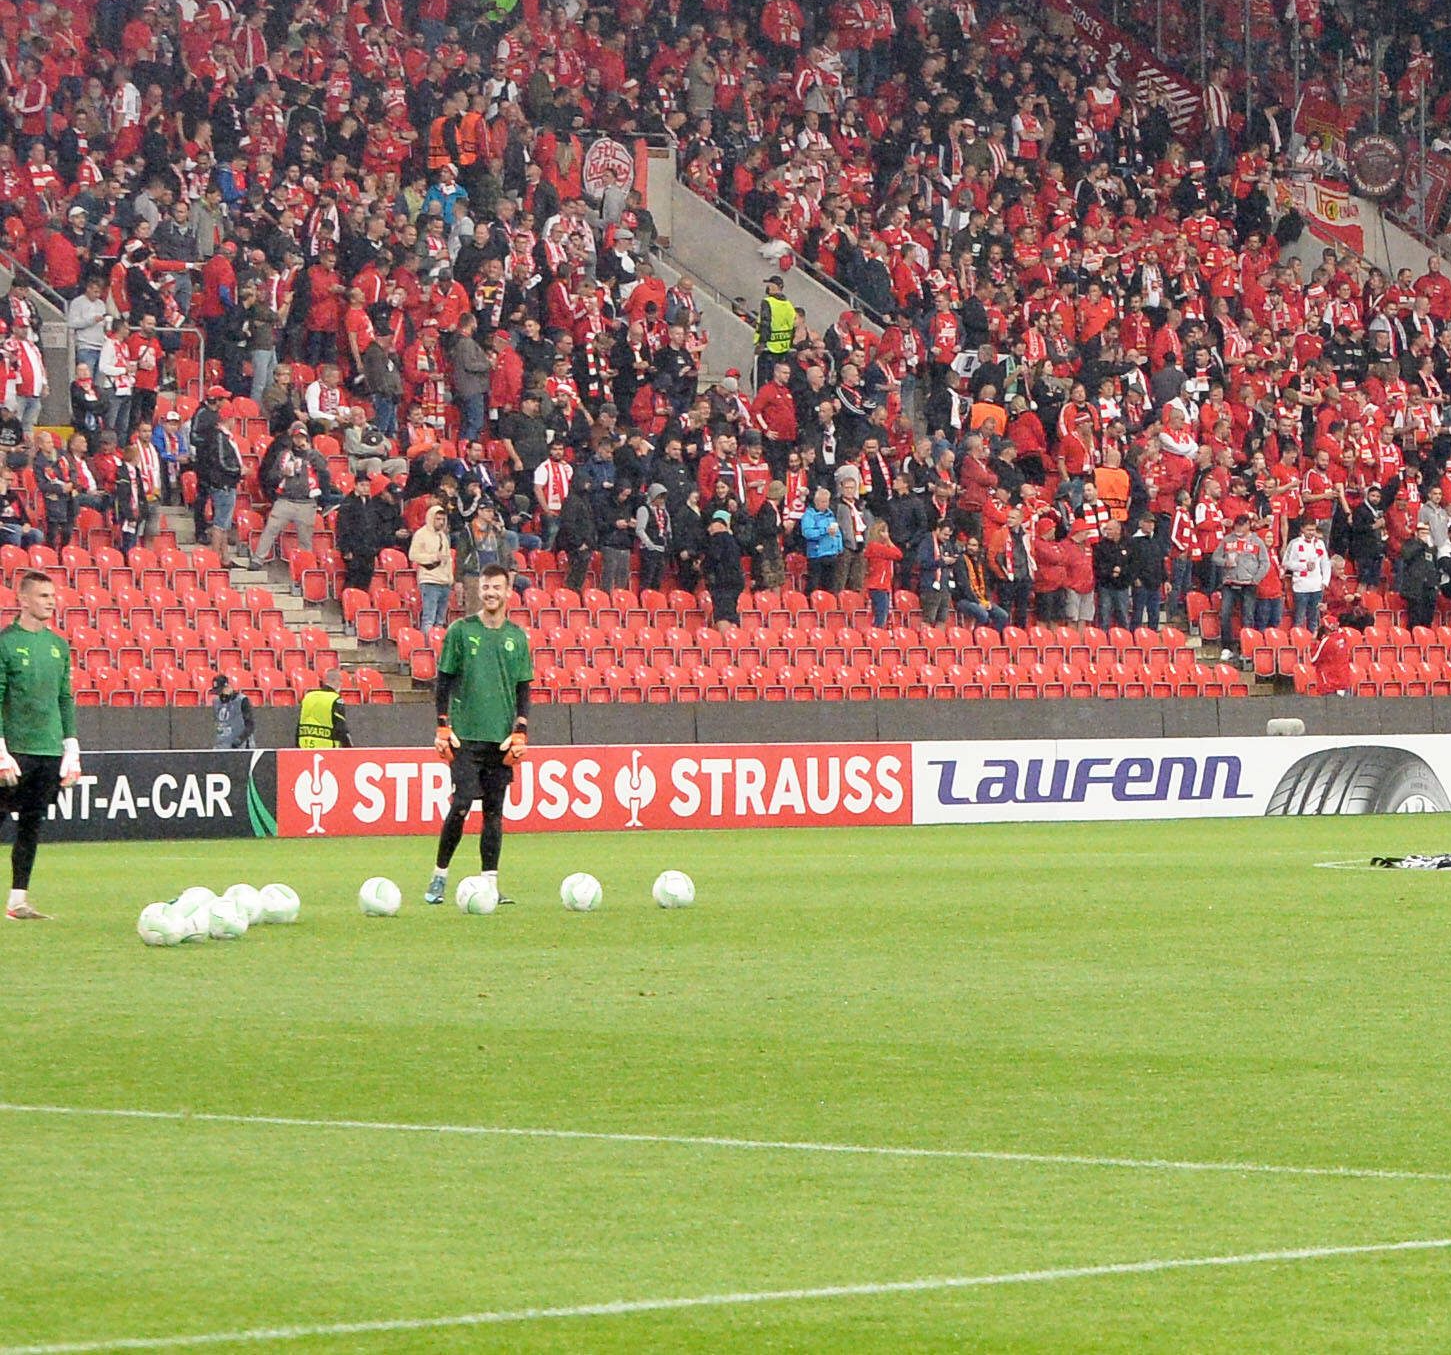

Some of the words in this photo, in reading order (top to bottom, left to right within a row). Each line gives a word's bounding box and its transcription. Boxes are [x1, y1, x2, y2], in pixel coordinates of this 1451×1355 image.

[352, 758, 603, 824] STRUSS
[669, 755, 904, 817] STRAUSS
[928, 755, 1254, 806] Laufenn
